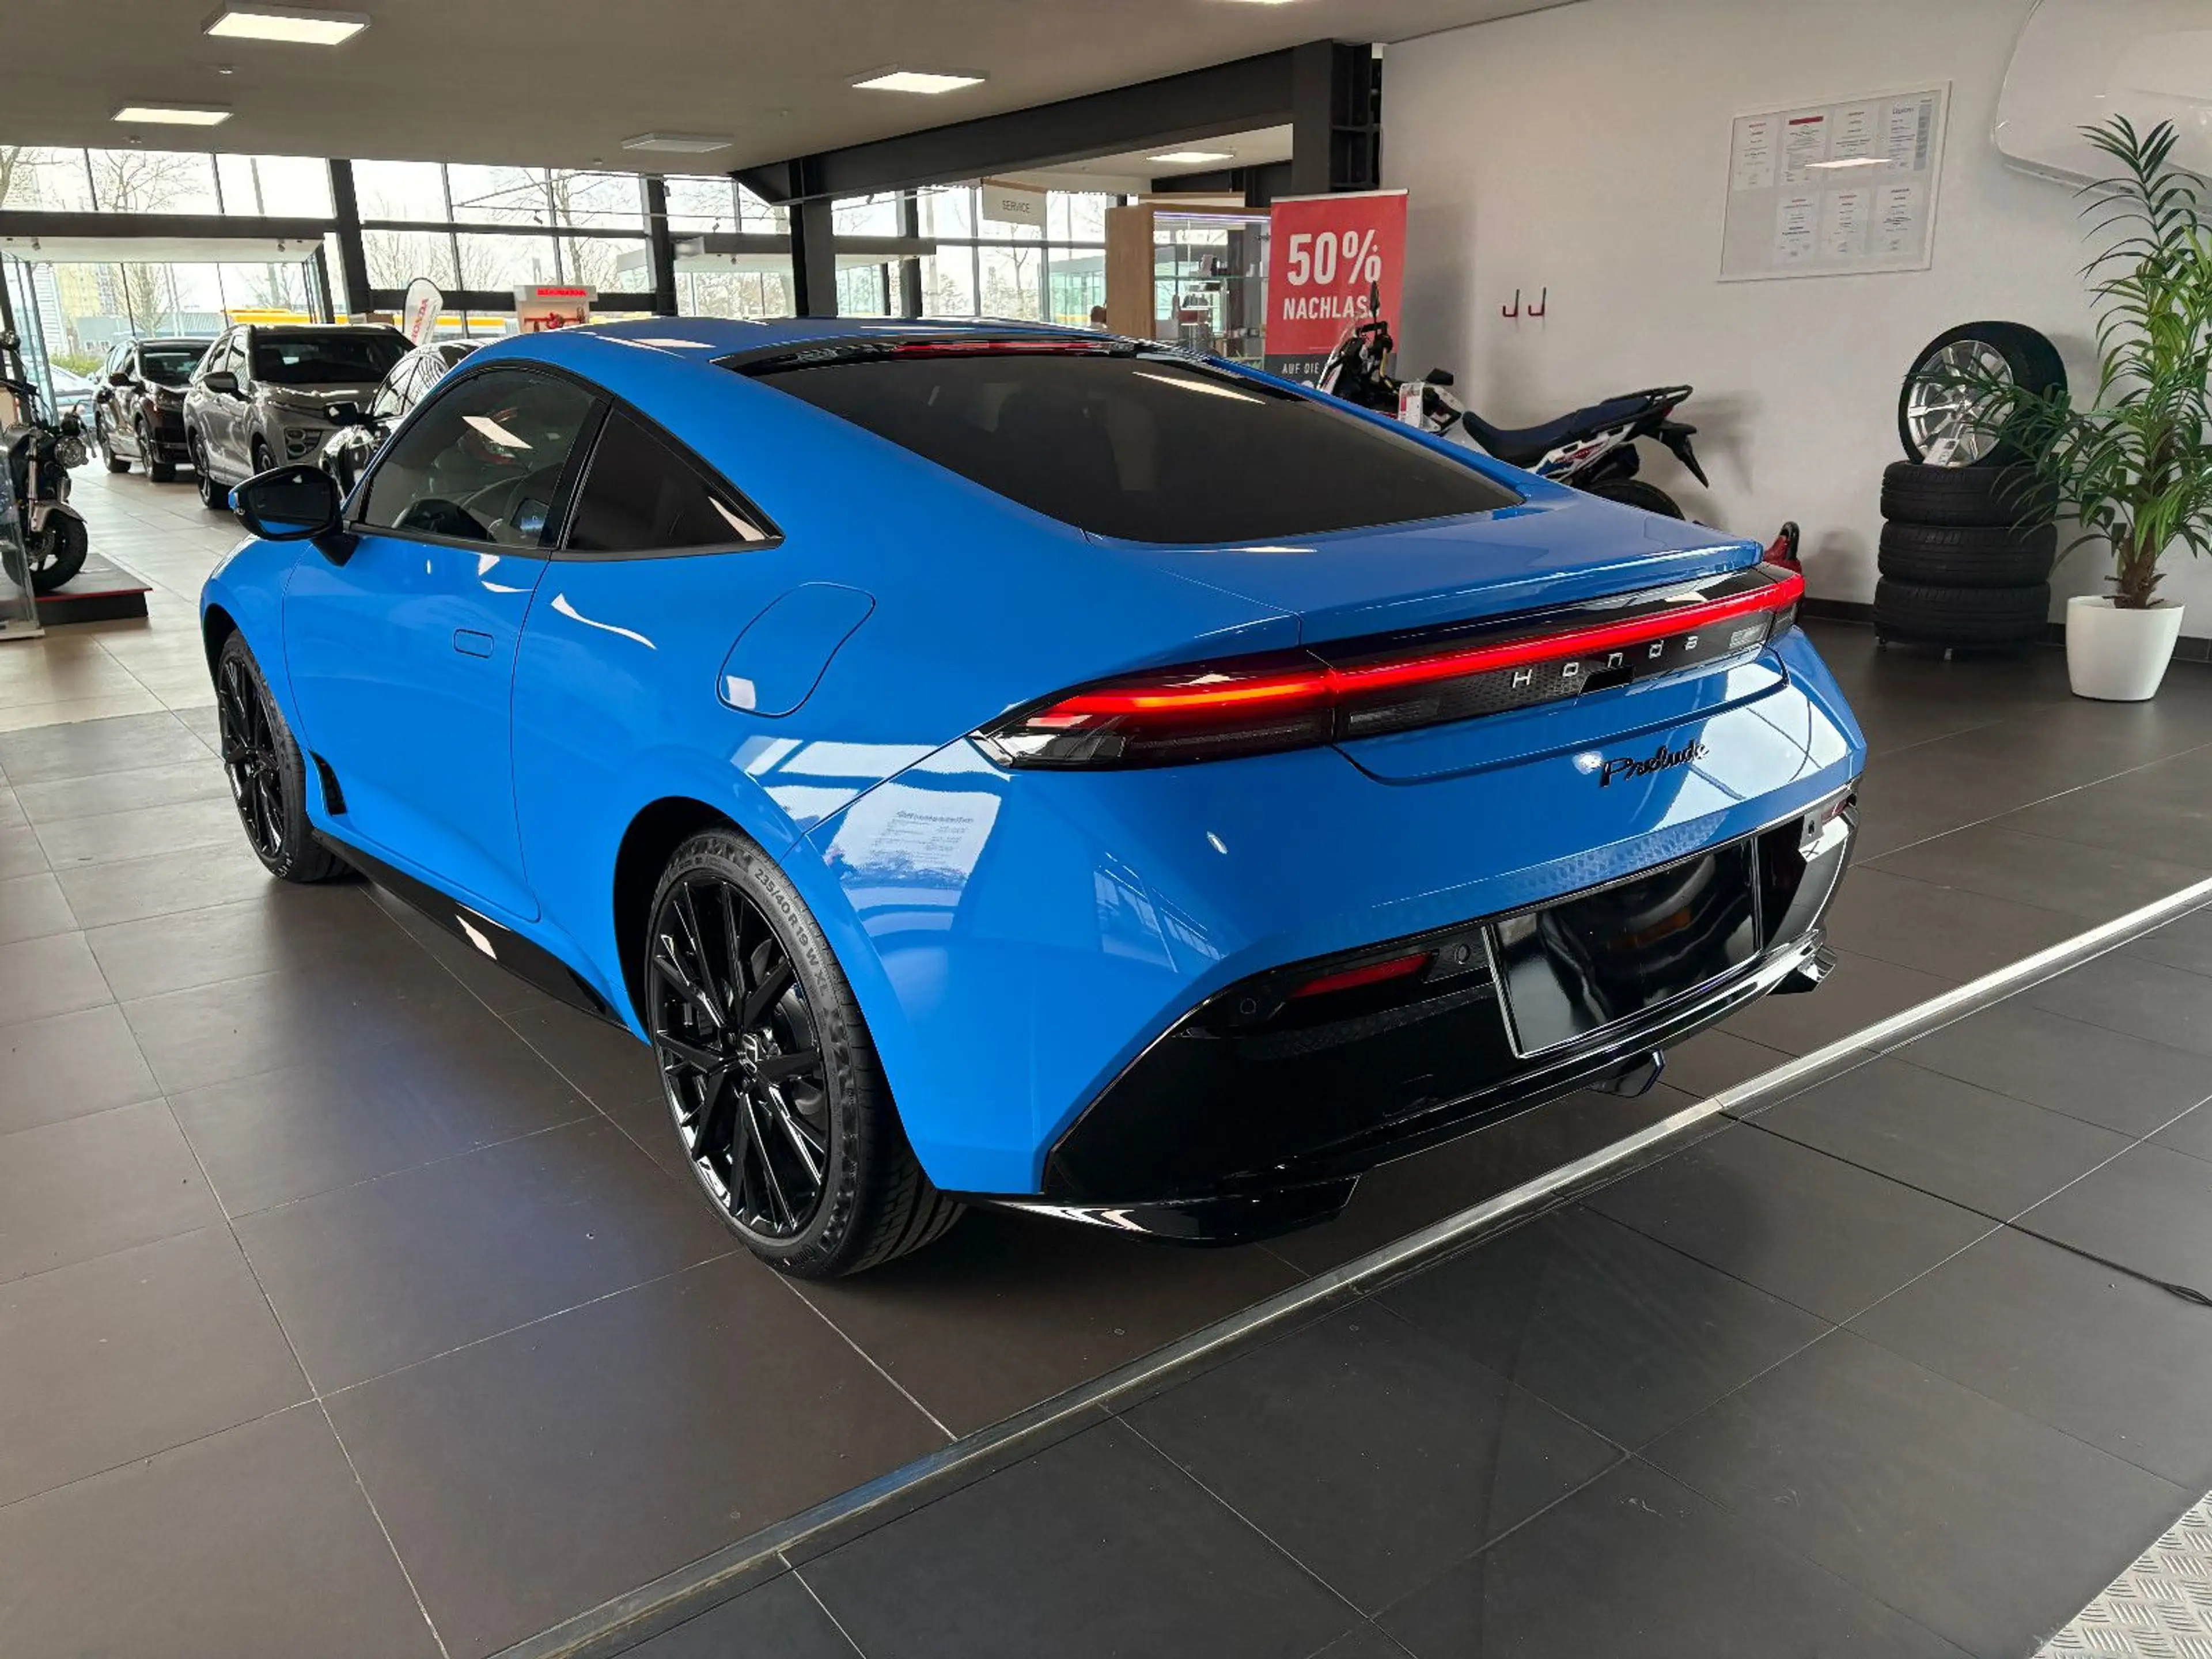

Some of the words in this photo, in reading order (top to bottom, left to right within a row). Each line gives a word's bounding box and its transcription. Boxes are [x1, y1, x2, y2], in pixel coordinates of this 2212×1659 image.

[1287, 229, 1382, 286] 50%
[1283, 295, 1380, 320] NACHLAS
[1281, 363, 1301, 374] AUF
[1304, 362, 1320, 374] DIE
[1600, 739, 1710, 788] Prelude
[754, 868, 791, 914] 235/40
